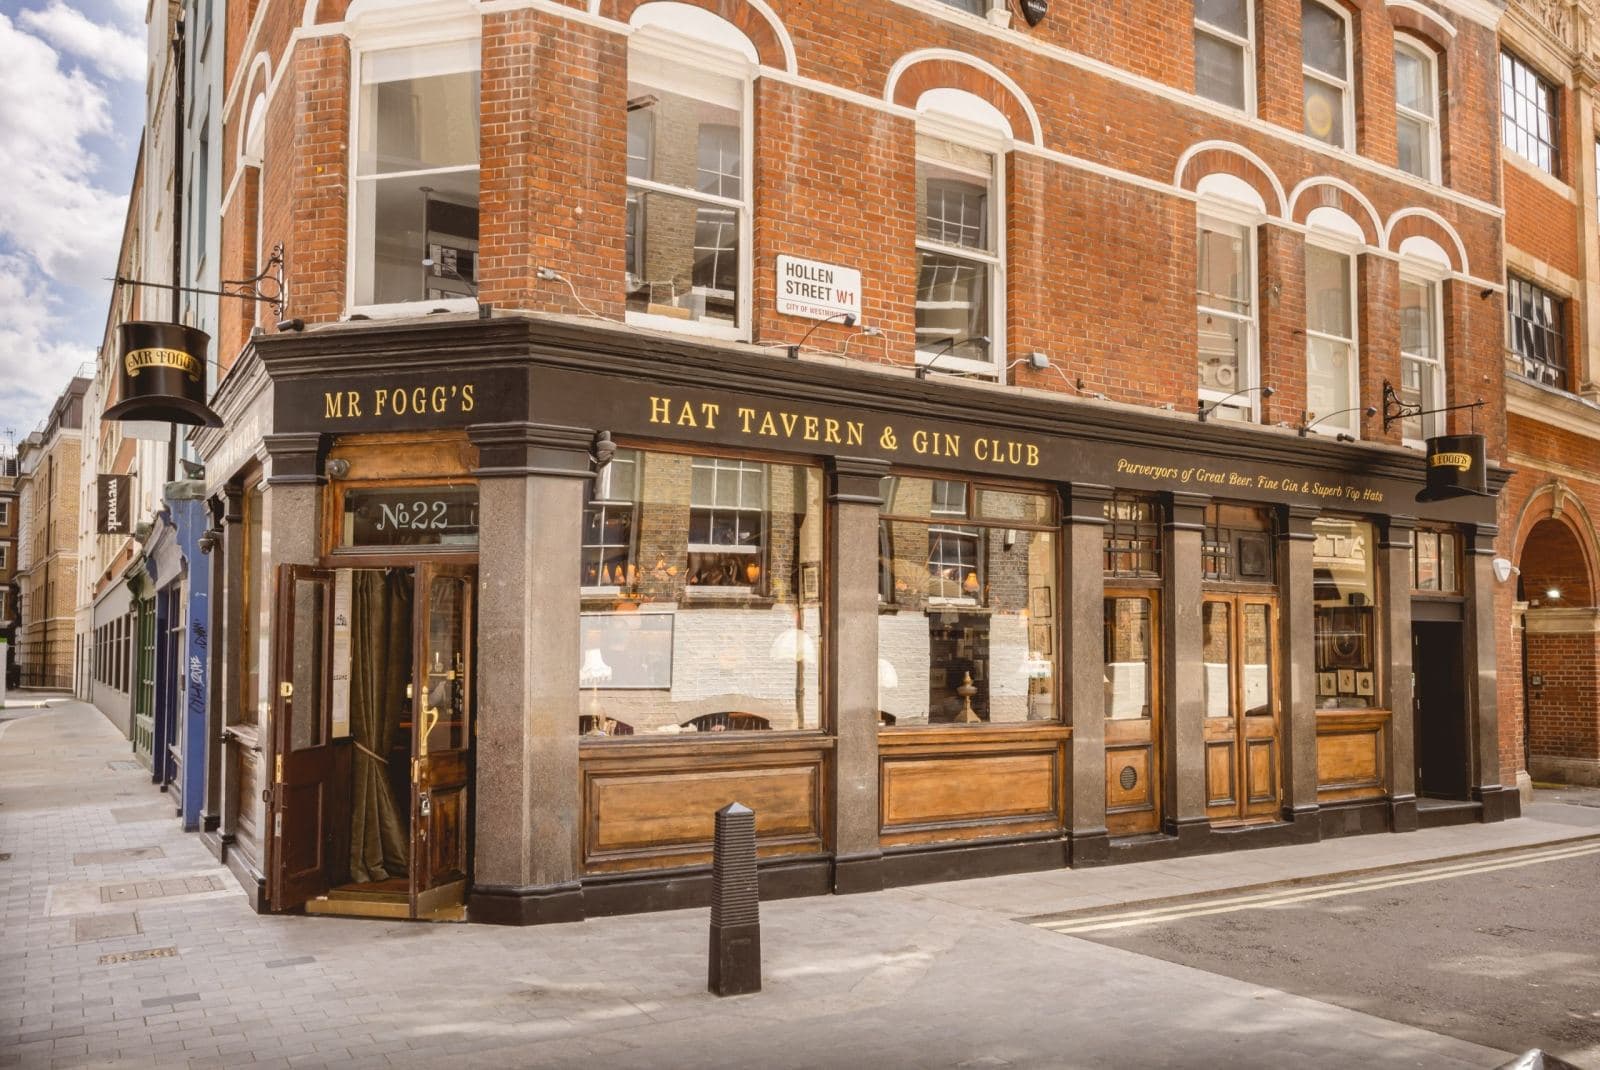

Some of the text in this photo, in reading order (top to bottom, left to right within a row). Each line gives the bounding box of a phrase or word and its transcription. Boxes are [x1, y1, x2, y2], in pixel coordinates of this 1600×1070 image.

[786, 262, 834, 284] HOLLEN
[786, 280, 854, 306] STREET W1
[786, 303, 799, 311] CITY
[800, 305, 808, 313] OF
[128, 351, 153, 367] MR
[324, 384, 475, 418] MR FOGG'S
[649, 396, 1040, 466] HAT TAVERN & GIN CLUB
[1117, 458, 1178, 480] Purveryors
[1181, 468, 1195, 483] of
[1196, 468, 1226, 484] Great
[1257, 475, 1278, 490] Fine
[1282, 478, 1298, 492] Gin
[1301, 482, 1309, 493] &
[1312, 482, 1343, 499] Superb
[1345, 486, 1360, 501] Top
[1363, 488, 1383, 502] Hats
[107, 478, 122, 532] wework
